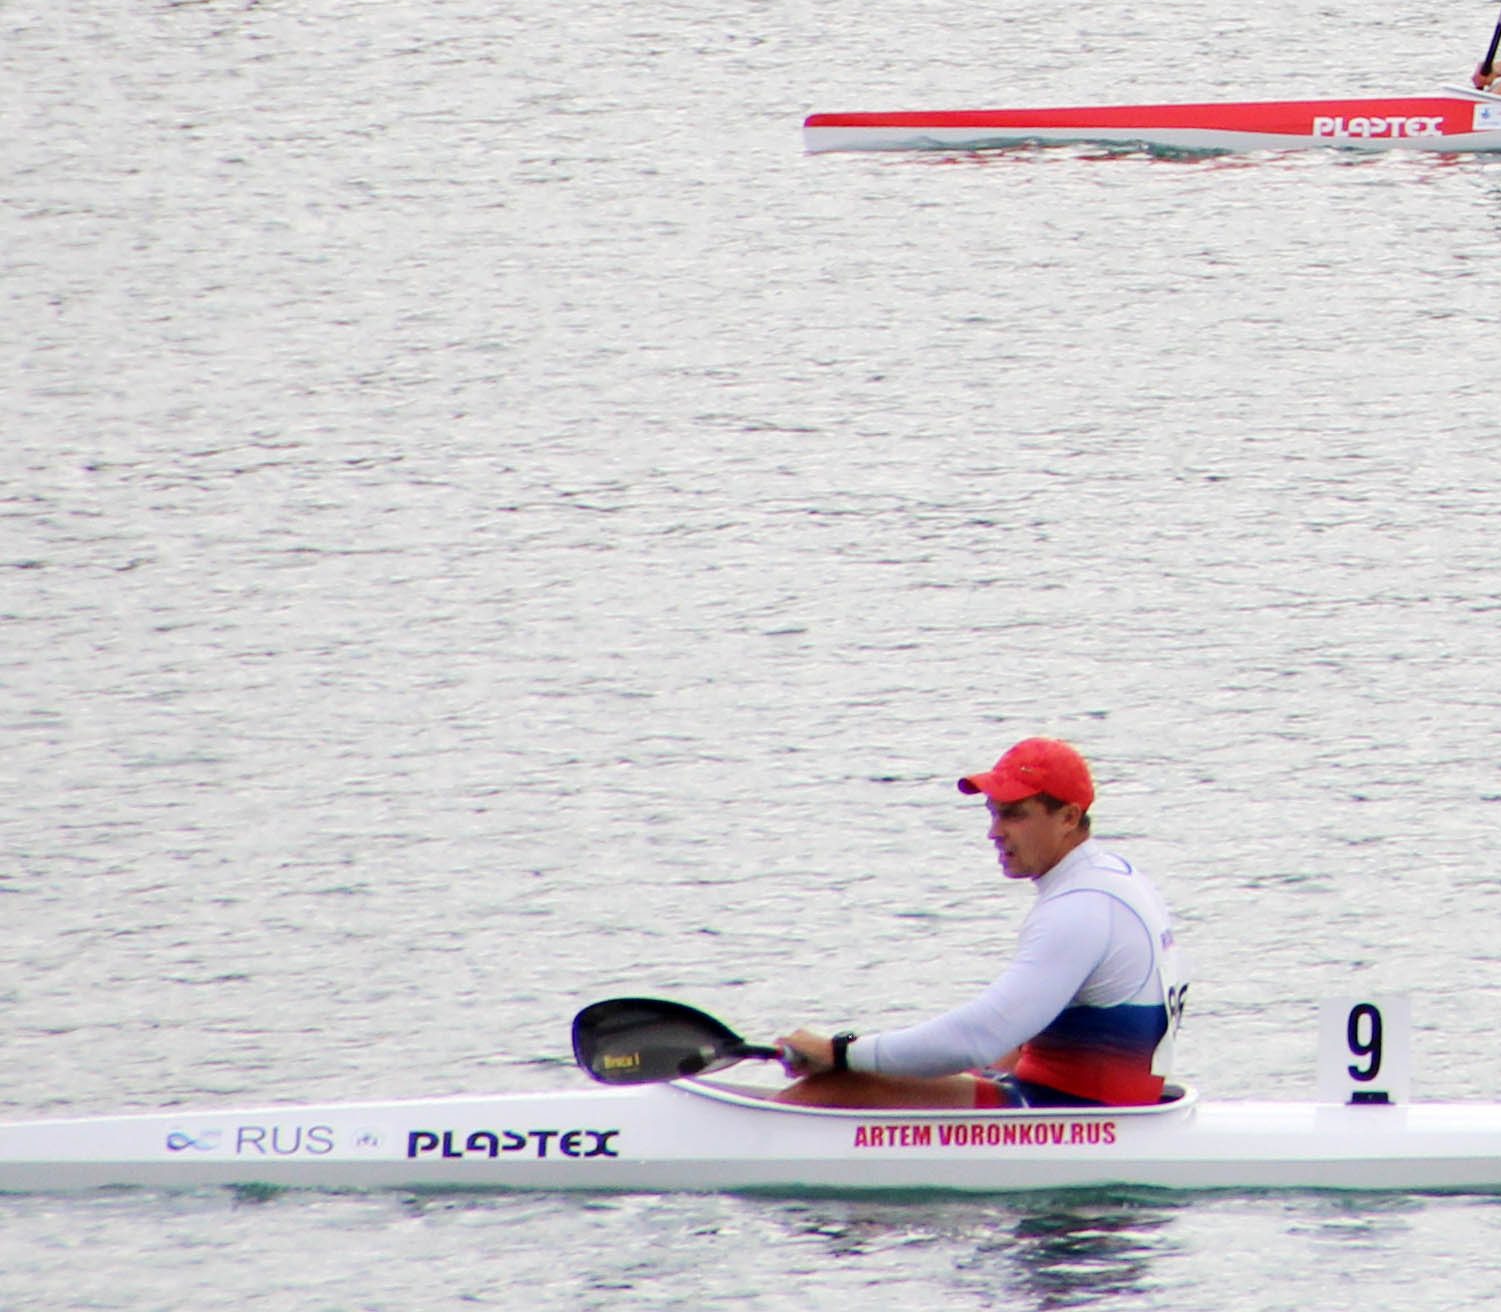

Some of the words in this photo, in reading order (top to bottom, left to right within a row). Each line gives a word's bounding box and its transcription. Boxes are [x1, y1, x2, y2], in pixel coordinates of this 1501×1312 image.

[1347, 1003, 1382, 1082] 9
[236, 1126, 334, 1154] RUS
[854, 1126, 931, 1147] ARTEM
[939, 1122, 1116, 1146] VORONKOV.RUS
